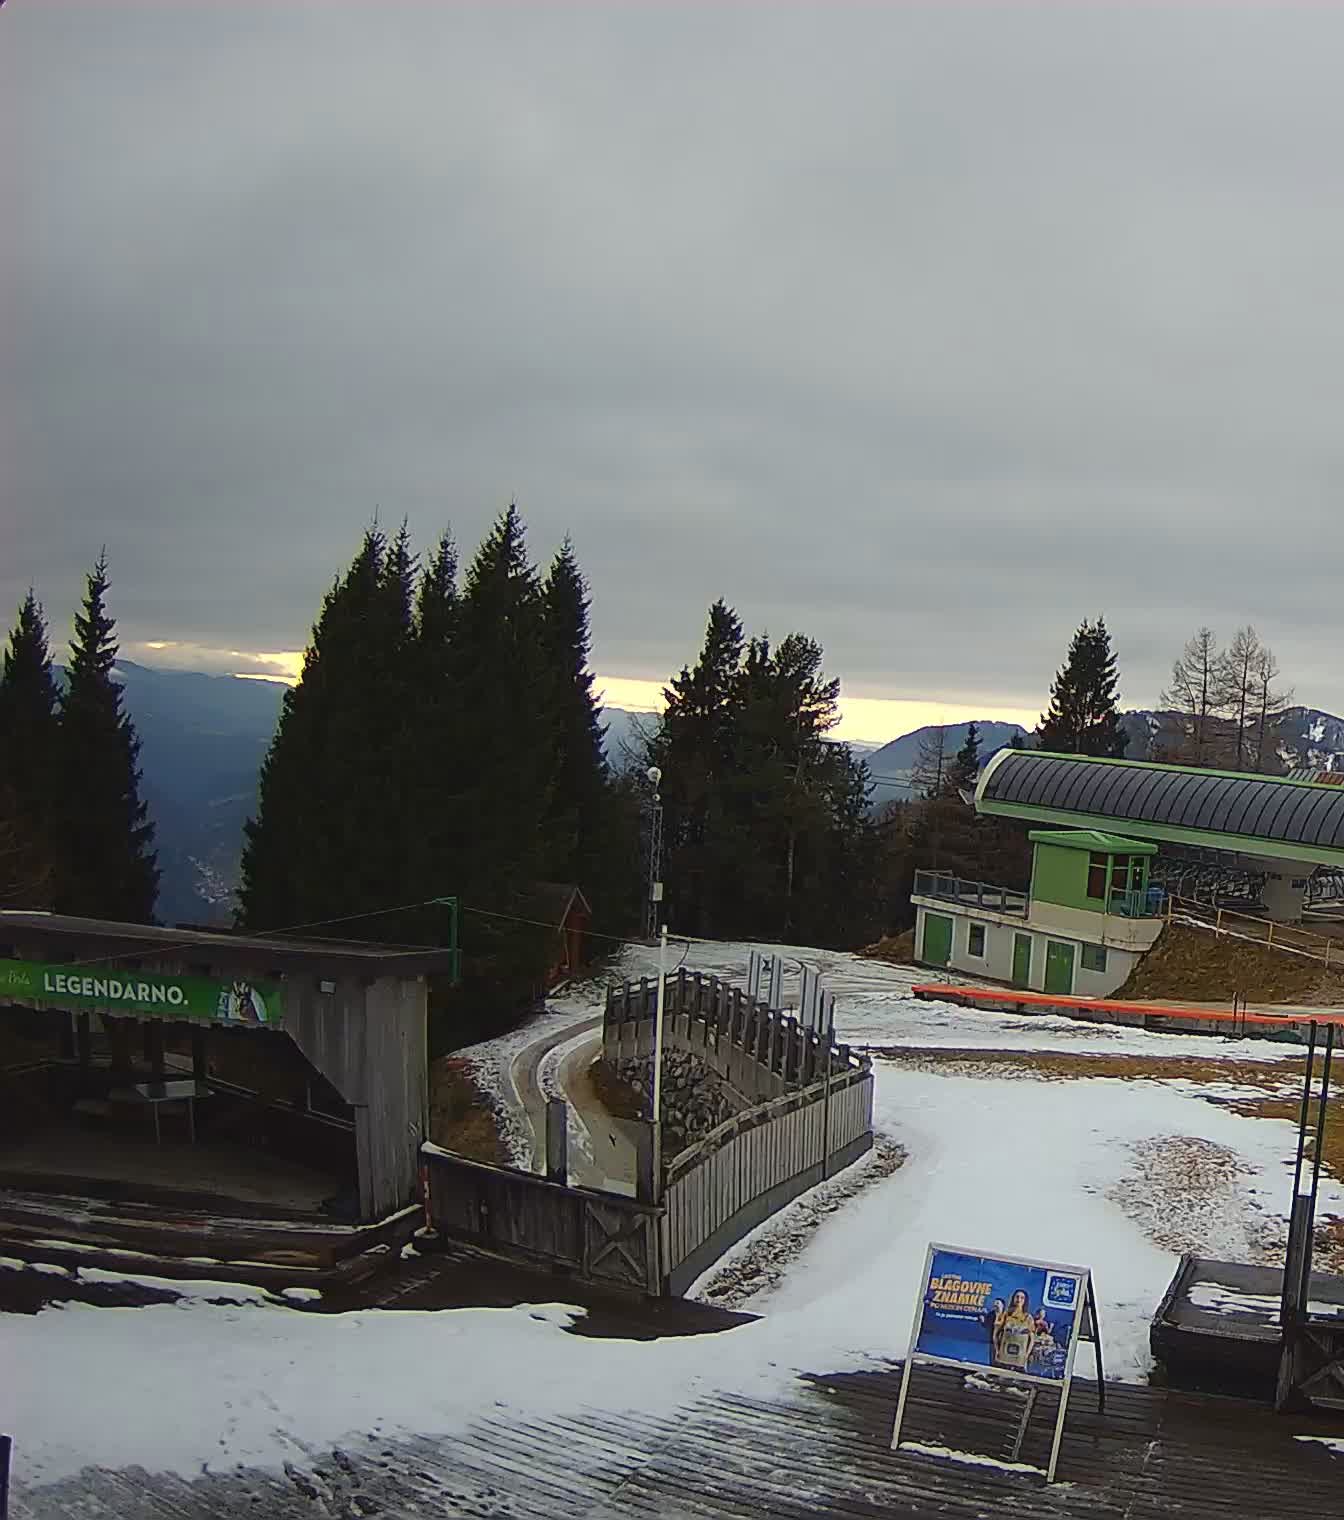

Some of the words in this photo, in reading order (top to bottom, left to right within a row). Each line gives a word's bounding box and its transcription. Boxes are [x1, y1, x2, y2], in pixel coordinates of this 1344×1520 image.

[43, 972, 189, 1006] LEGENDARNO.
[930, 1277, 993, 1295] BLAGOVNE
[932, 1290, 985, 1307] ZNAMKE
